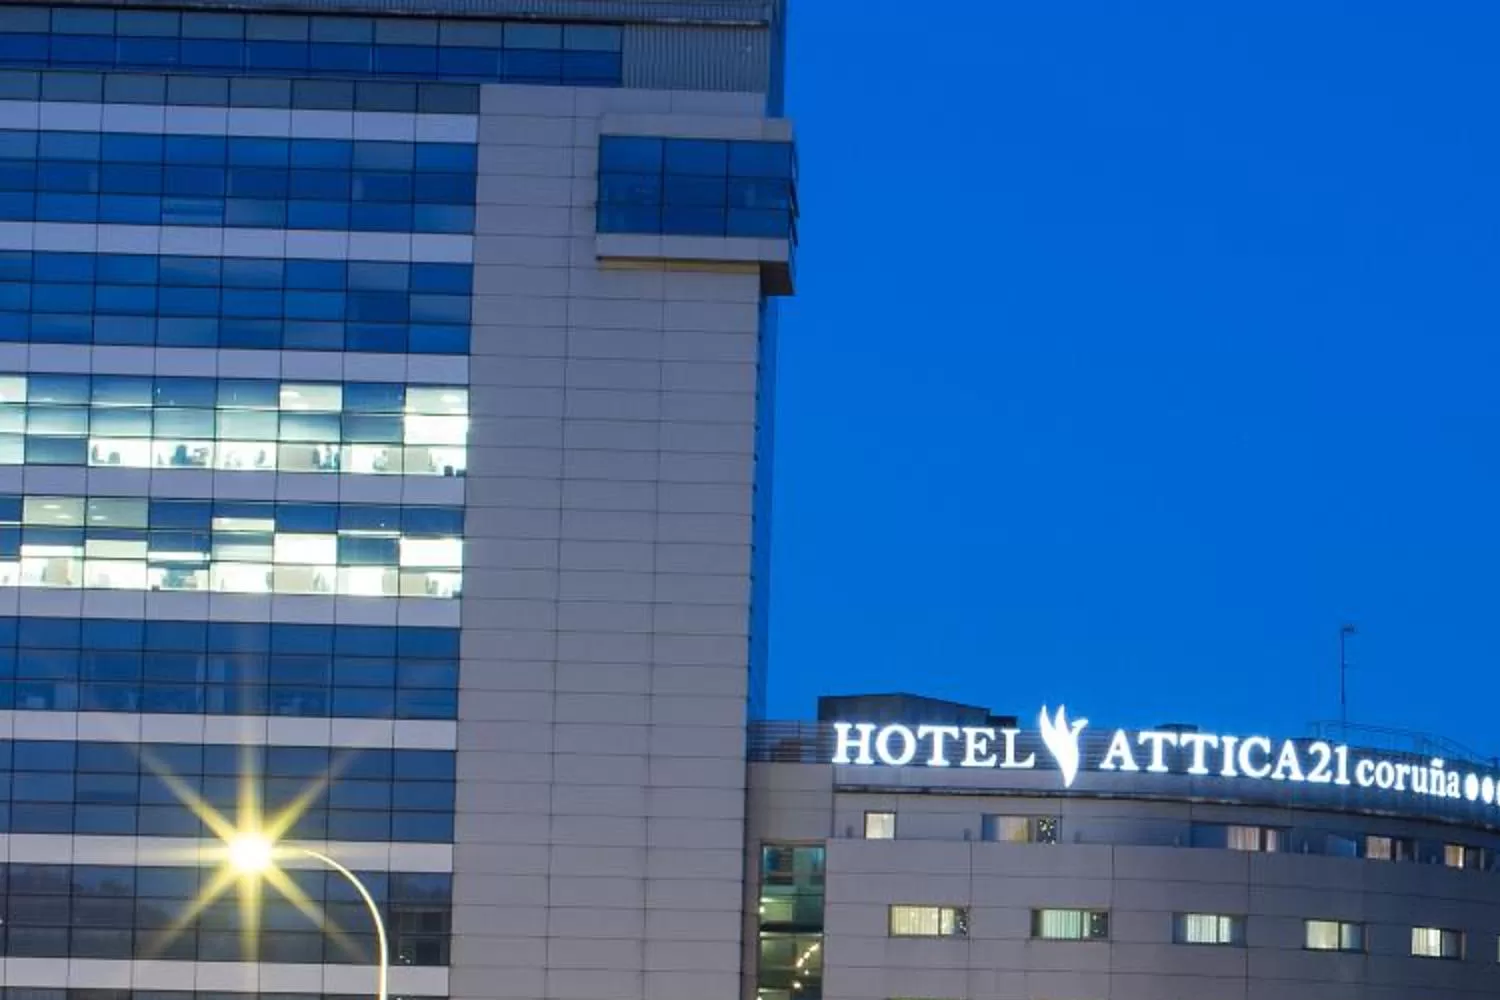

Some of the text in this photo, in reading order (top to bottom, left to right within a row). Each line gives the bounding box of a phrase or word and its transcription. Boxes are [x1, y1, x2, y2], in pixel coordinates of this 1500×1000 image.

[832, 722, 1460, 798] HOTEL ATTICA21 coruña
